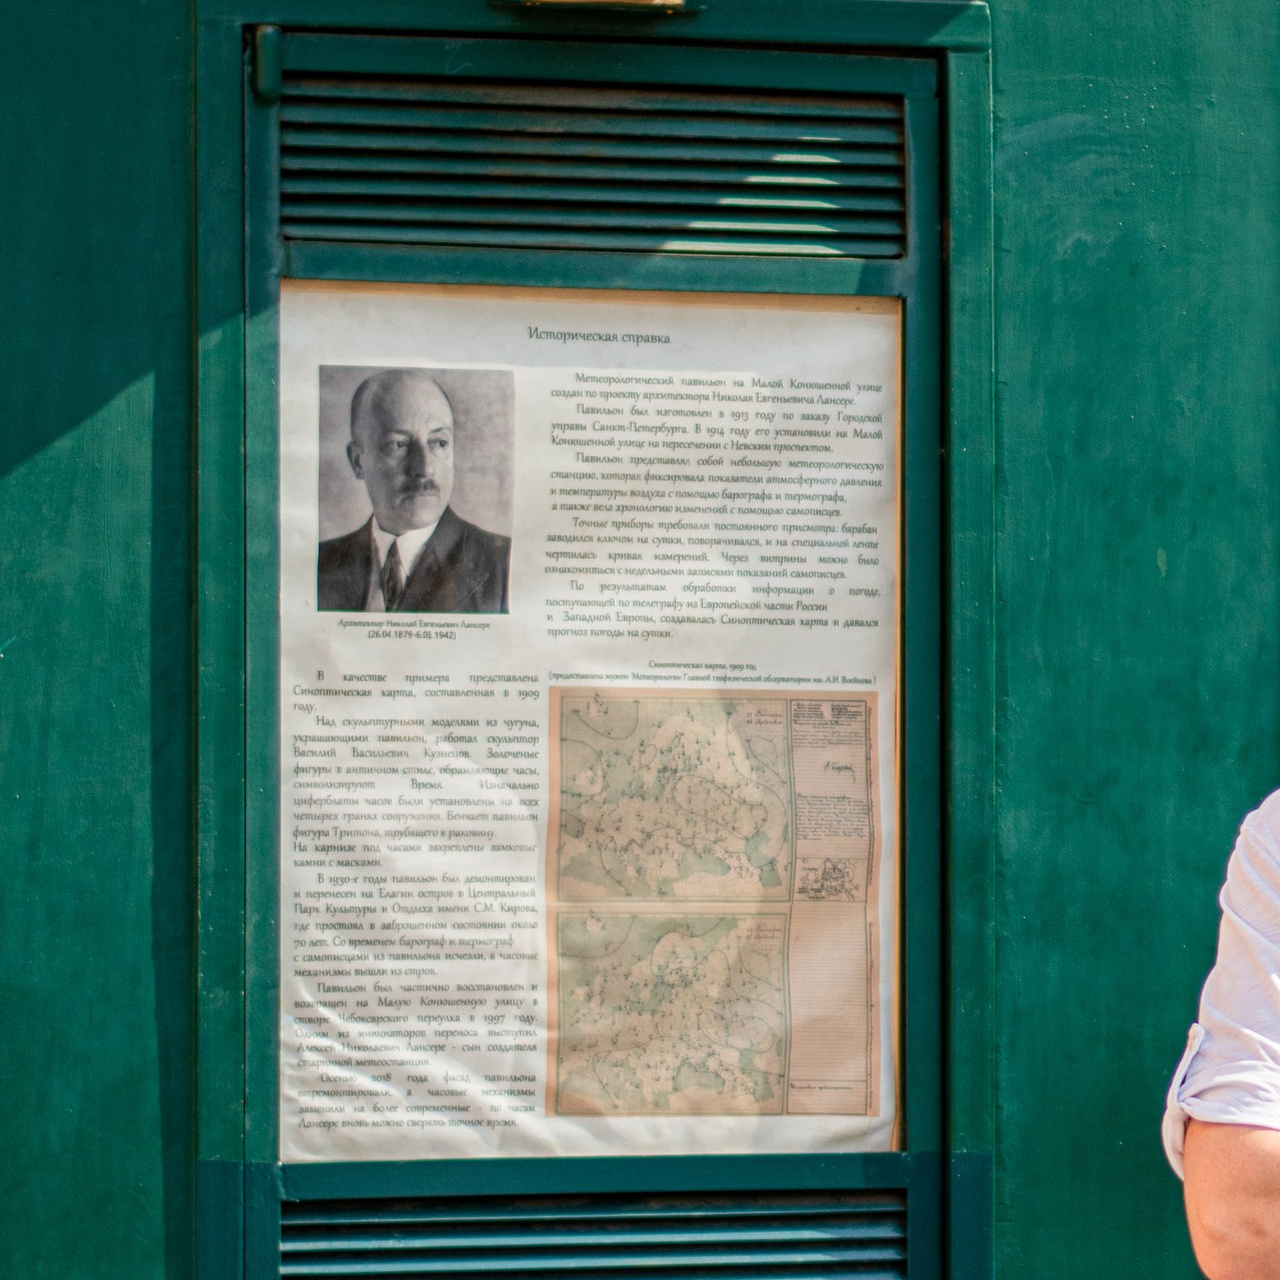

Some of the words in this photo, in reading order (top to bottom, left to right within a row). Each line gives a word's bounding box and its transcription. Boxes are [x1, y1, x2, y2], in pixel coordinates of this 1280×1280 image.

[528, 326, 618, 344] Историческая
[622, 334, 671, 346] справка
[575, 373, 674, 386] Метеорологический
[752, 378, 783, 388] Малой
[790, 379, 850, 390] Конюшенной
[857, 384, 882, 394] улице
[550, 390, 583, 399] создан
[599, 391, 640, 402] проекту
[643, 392, 710, 404] архитектора
[712, 391, 753, 402] Николая
[756, 392, 814, 404] Евгеньевича
[577, 404, 623, 415] Павильон
[631, 405, 649, 415] был
[656, 409, 712, 417] изготовлен
[731, 411, 749, 421] 1913
[756, 412, 776, 423] году
[800, 413, 831, 424] заказу
[838, 411, 882, 425] Городской
[551, 423, 587, 433] управы
[707, 427, 724, 437] 1914
[730, 428, 750, 439] году
[774, 429, 831, 440] установили
[853, 428, 882, 439] Малой
[551, 435, 615, 446] Конюшенной
[618, 440, 646, 450] улице
[662, 441, 721, 451] пересечении
[731, 440, 771, 450] Невским
[576, 452, 623, 463] Павильон
[630, 457, 690, 467] представлял
[697, 455, 723, 466] собой
[731, 456, 782, 471] небольшую
[788, 461, 884, 475] метеорологическую
[601, 473, 641, 483] которая
[644, 470, 705, 484] фиксировала
[708, 475, 763, 483] показатели
[766, 473, 837, 488] атмосферного
[840, 479, 882, 487] давления
[559, 489, 627, 500] температуры
[630, 490, 666, 501] воздуха
[675, 491, 719, 500] помощью
[721, 489, 772, 503] барографа
[615, 505, 673, 515] хронологию
[675, 505, 728, 514] изменений
[738, 507, 784, 516] помощью
[573, 517, 608, 528] Точные
[612, 518, 654, 531] приборы
[658, 519, 710, 532] требовали
[714, 523, 778, 531] постоянного
[842, 522, 877, 536] барабан
[546, 535, 593, 544] заводился
[791, 539, 849, 548] специальной
[853, 541, 879, 549] ленте
[546, 552, 597, 561] чертилась
[608, 553, 642, 563] кривая
[721, 552, 749, 565] Через
[760, 556, 807, 566] витрины
[858, 554, 879, 565] было
[624, 568, 685, 576] недельными
[737, 569, 788, 577] показаний
[570, 580, 584, 590] По
[600, 584, 667, 594] результатам
[683, 581, 736, 595] обработки
[752, 583, 814, 597] информации
[546, 598, 615, 610] поступающей
[633, 597, 684, 611] телеграфу
[700, 598, 761, 612] Европейской
[796, 600, 827, 611] России
[563, 611, 611, 623] Западной
[721, 614, 795, 625] Синоптическая
[800, 619, 828, 629] карта
[843, 620, 878, 628] давался
[548, 629, 588, 639] прогноз
[590, 629, 625, 638] погоды
